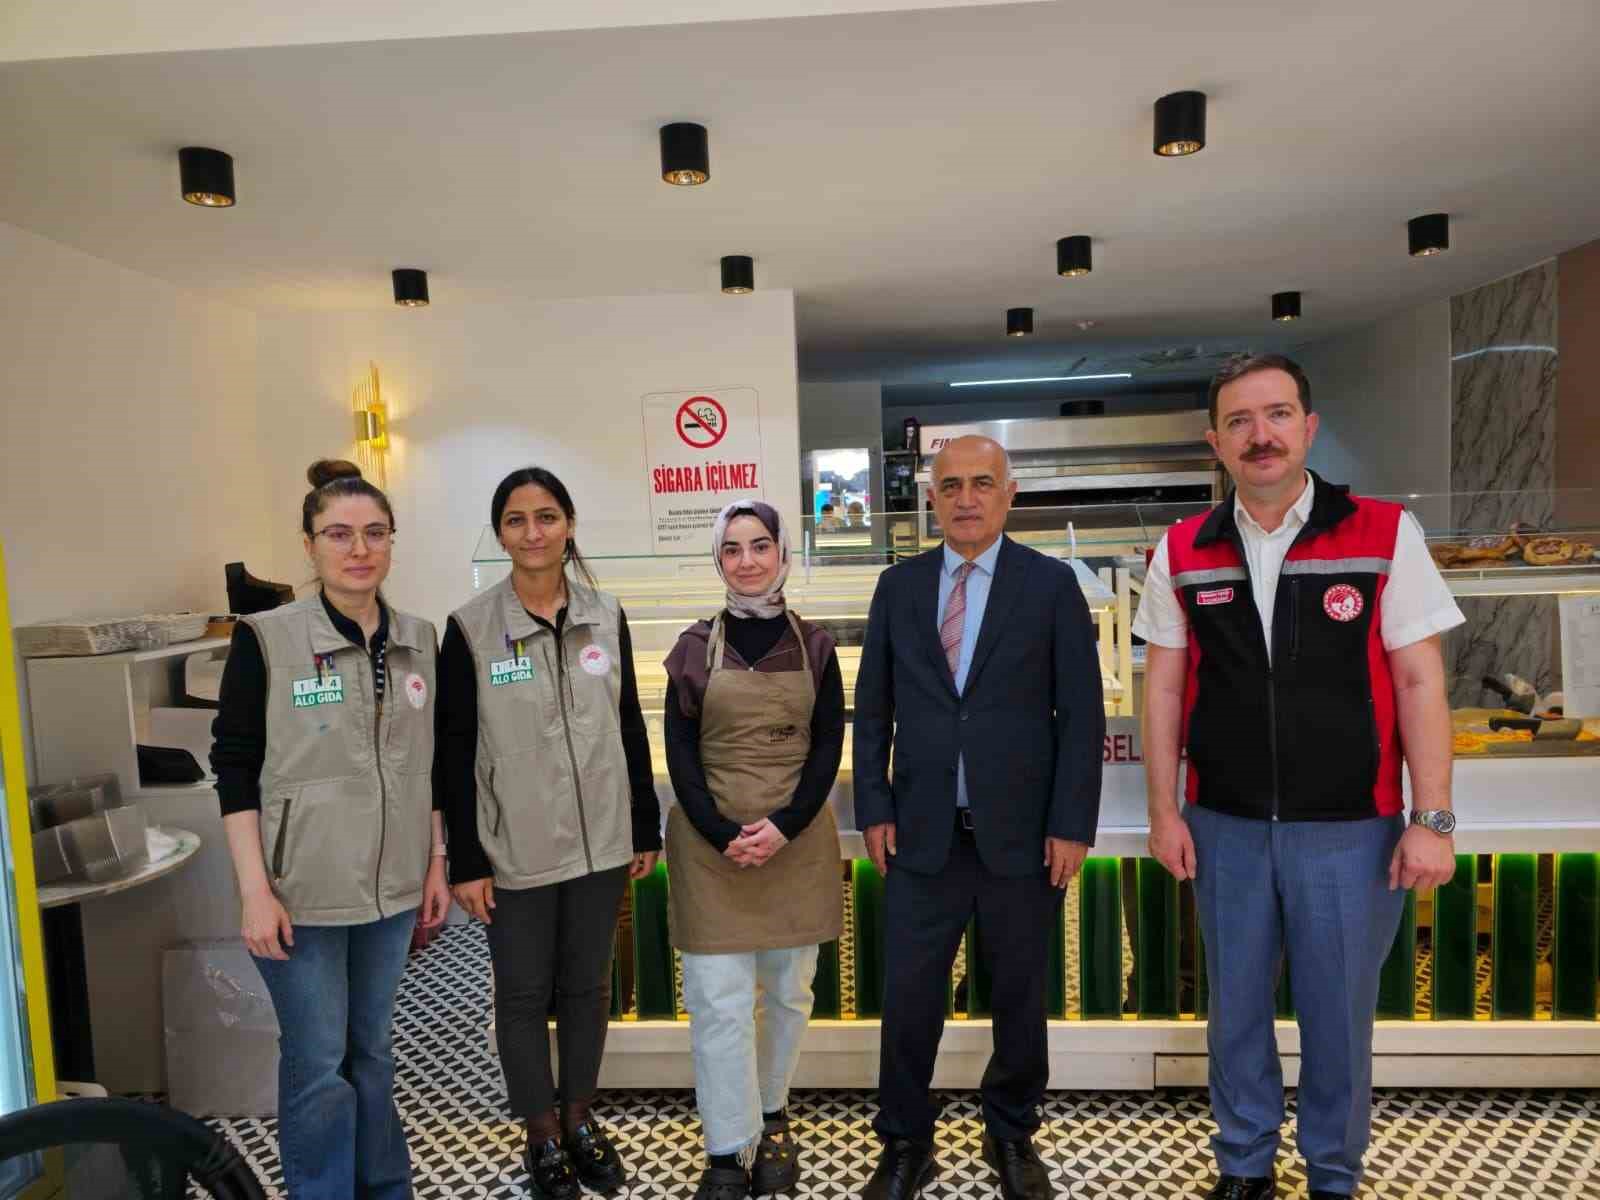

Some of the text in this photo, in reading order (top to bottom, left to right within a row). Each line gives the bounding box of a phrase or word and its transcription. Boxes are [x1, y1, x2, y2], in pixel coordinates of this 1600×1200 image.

[653, 460, 759, 494] SİGARA İÇİLMEZ
[492, 670, 533, 685] ALO GIDA
[295, 691, 343, 706] ALO GIDA
[1103, 734, 1145, 762] SEL
